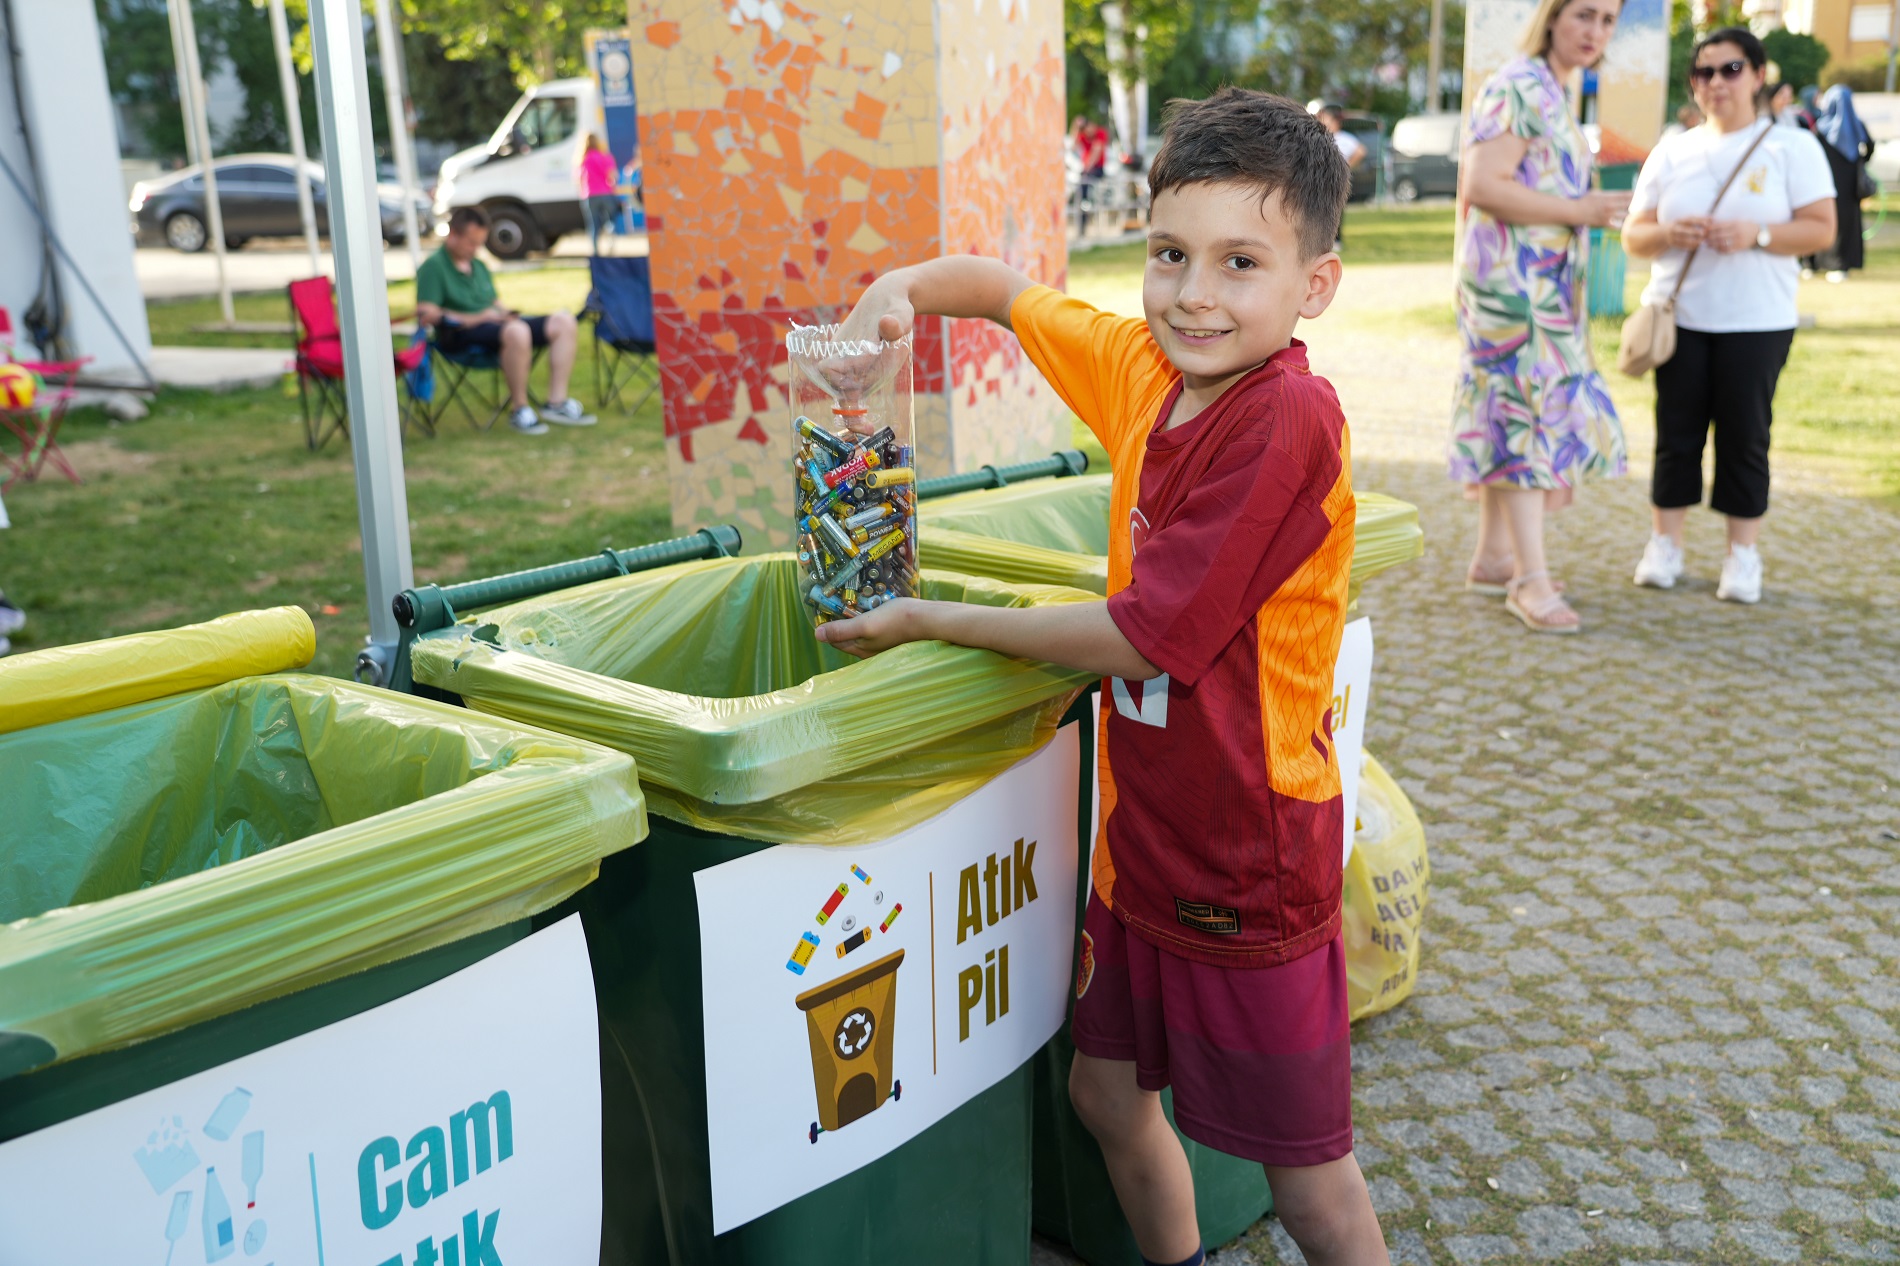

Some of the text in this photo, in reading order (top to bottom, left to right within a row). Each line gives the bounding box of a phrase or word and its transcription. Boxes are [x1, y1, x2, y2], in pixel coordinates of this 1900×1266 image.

[830, 455, 863, 477] KODAK
[956, 837, 1039, 945] Atık
[958, 943, 1010, 1043] Pil
[357, 1089, 514, 1231] Cam
